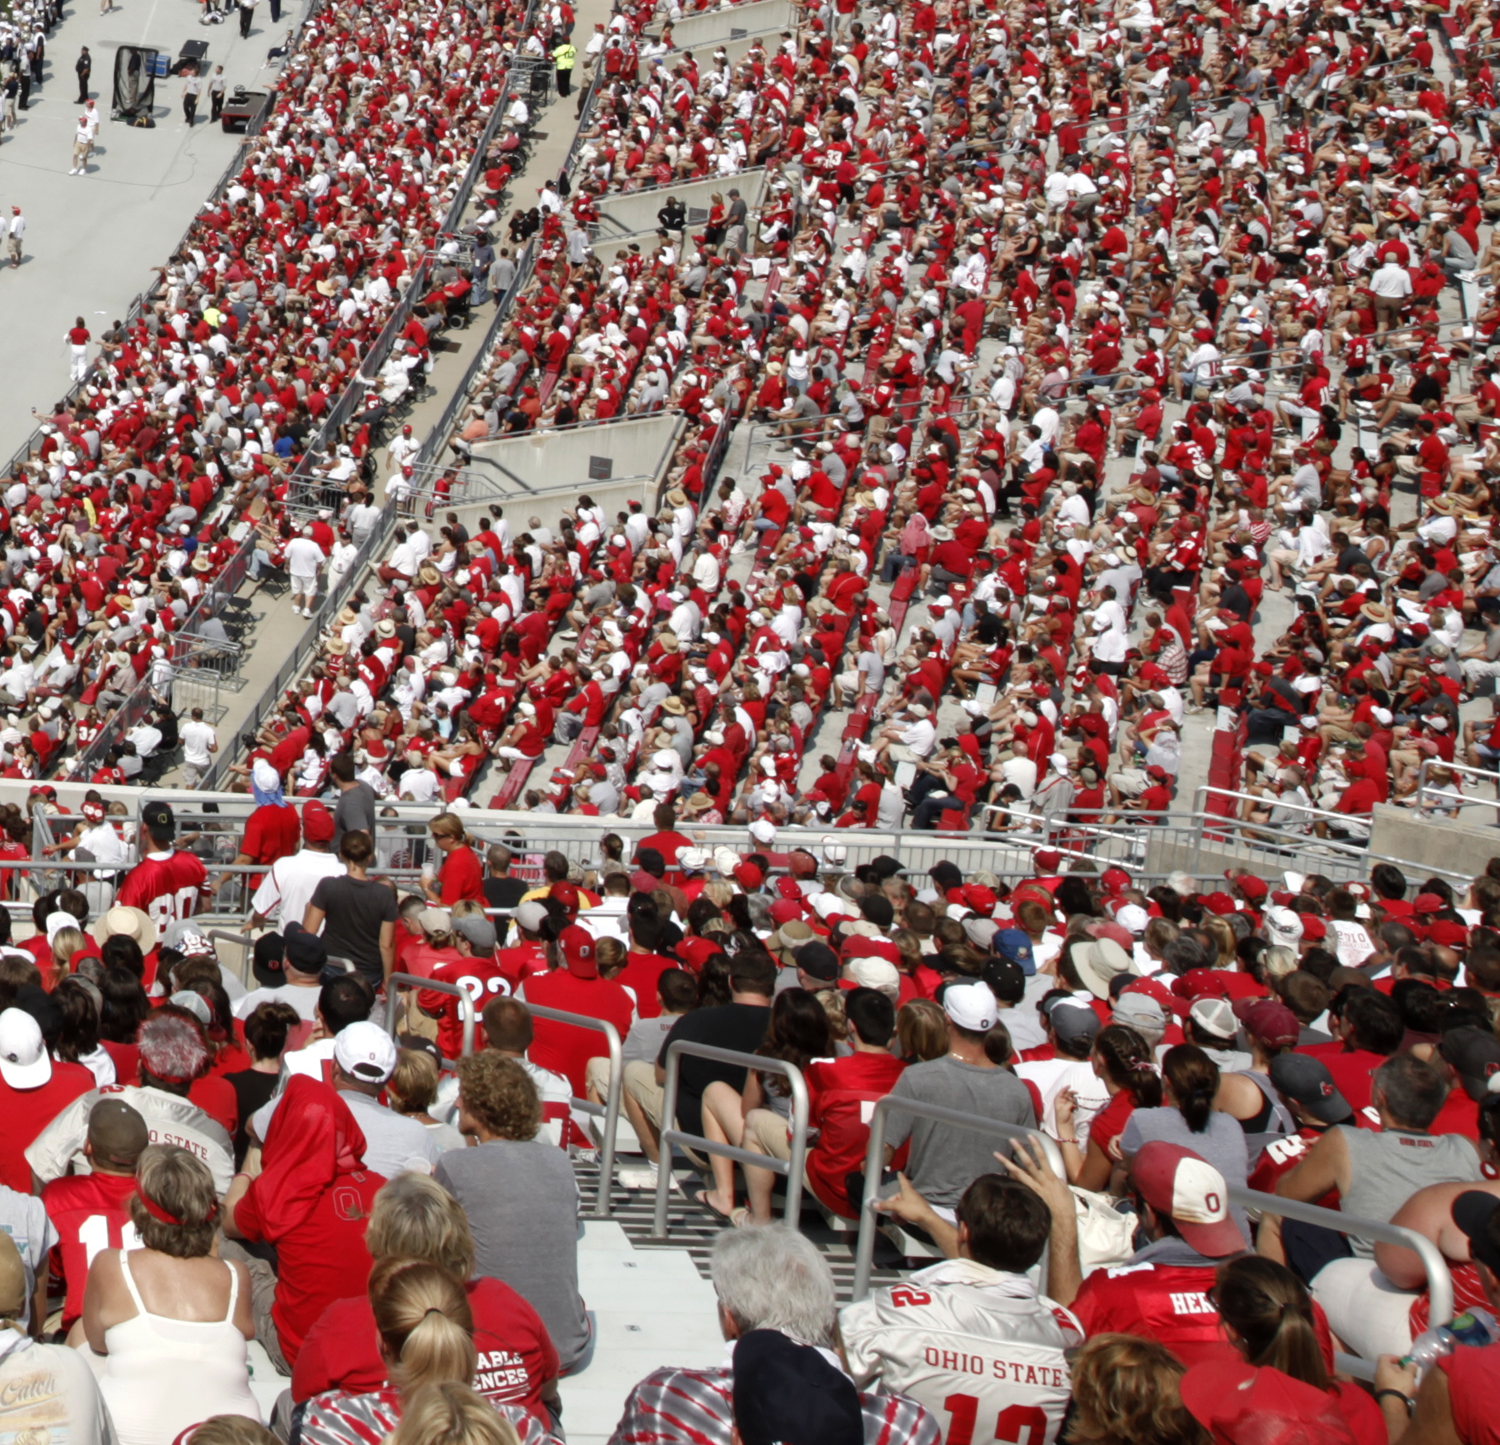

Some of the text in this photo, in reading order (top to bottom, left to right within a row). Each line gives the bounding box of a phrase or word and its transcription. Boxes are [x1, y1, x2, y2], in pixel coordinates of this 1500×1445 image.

[1205, 1191, 1221, 1214] O
[925, 1346, 1064, 1389] OHIO STATE
[0, 1376, 57, 1407] Catch
